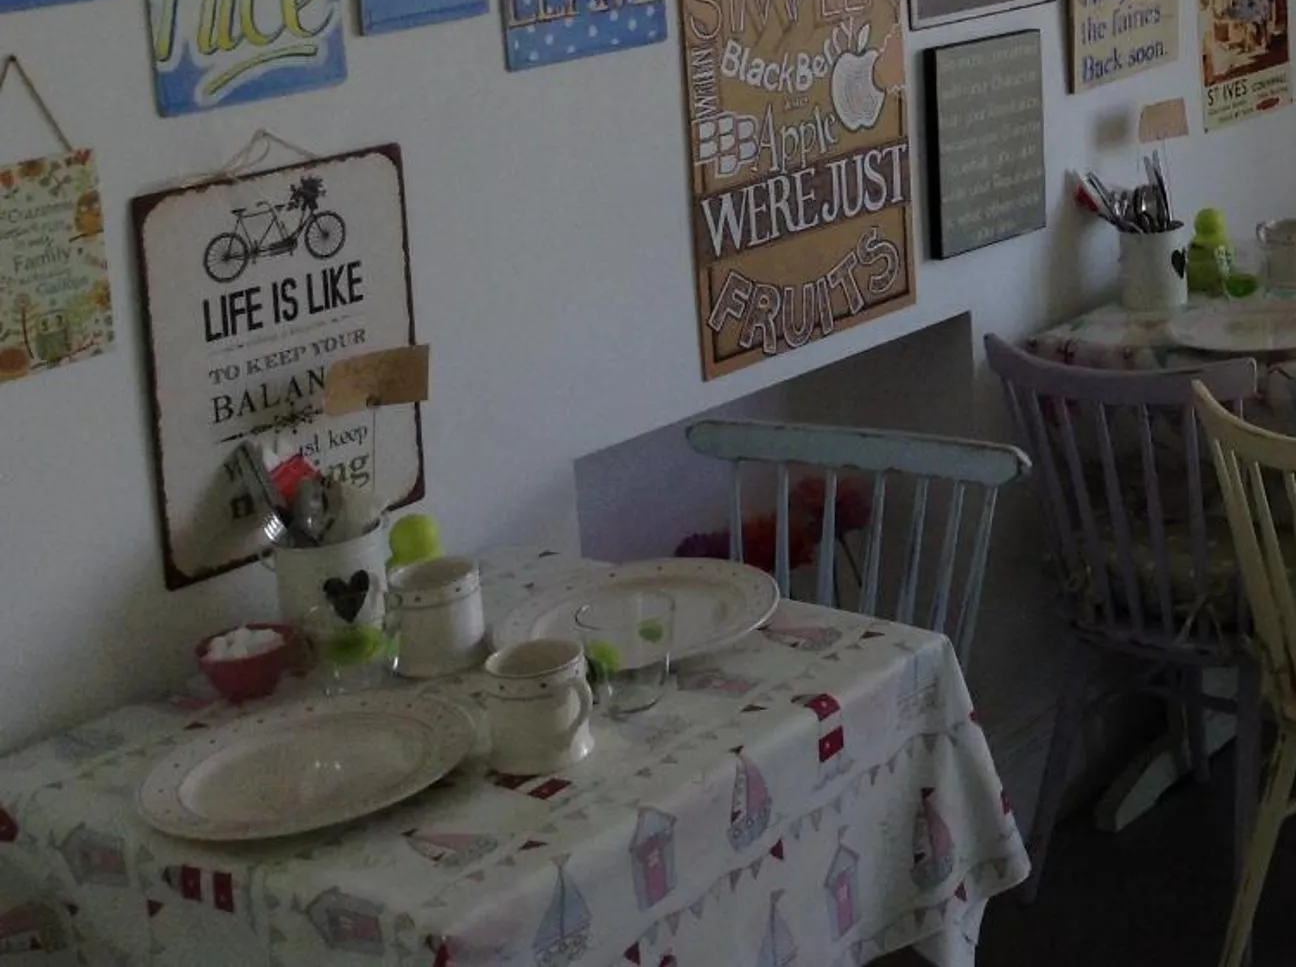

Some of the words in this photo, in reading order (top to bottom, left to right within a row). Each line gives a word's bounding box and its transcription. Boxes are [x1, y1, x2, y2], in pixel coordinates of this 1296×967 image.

[1081, 16, 1107, 46] the
[1112, 4, 1162, 37] fairies
[1082, 47, 1123, 83] Back
[758, 101, 840, 173] Apple
[699, 167, 821, 258] WERE
[821, 142, 909, 224] JUST
[202, 285, 264, 343] LIFE
[271, 277, 299, 325] IS
[306, 260, 364, 315] LIKE
[706, 224, 901, 356] FRUITS
[208, 364, 241, 385] TO
[246, 345, 307, 376] KEEP
[311, 328, 366, 357] YOUR
[210, 365, 326, 425] BALAN
[328, 422, 368, 449] keep
